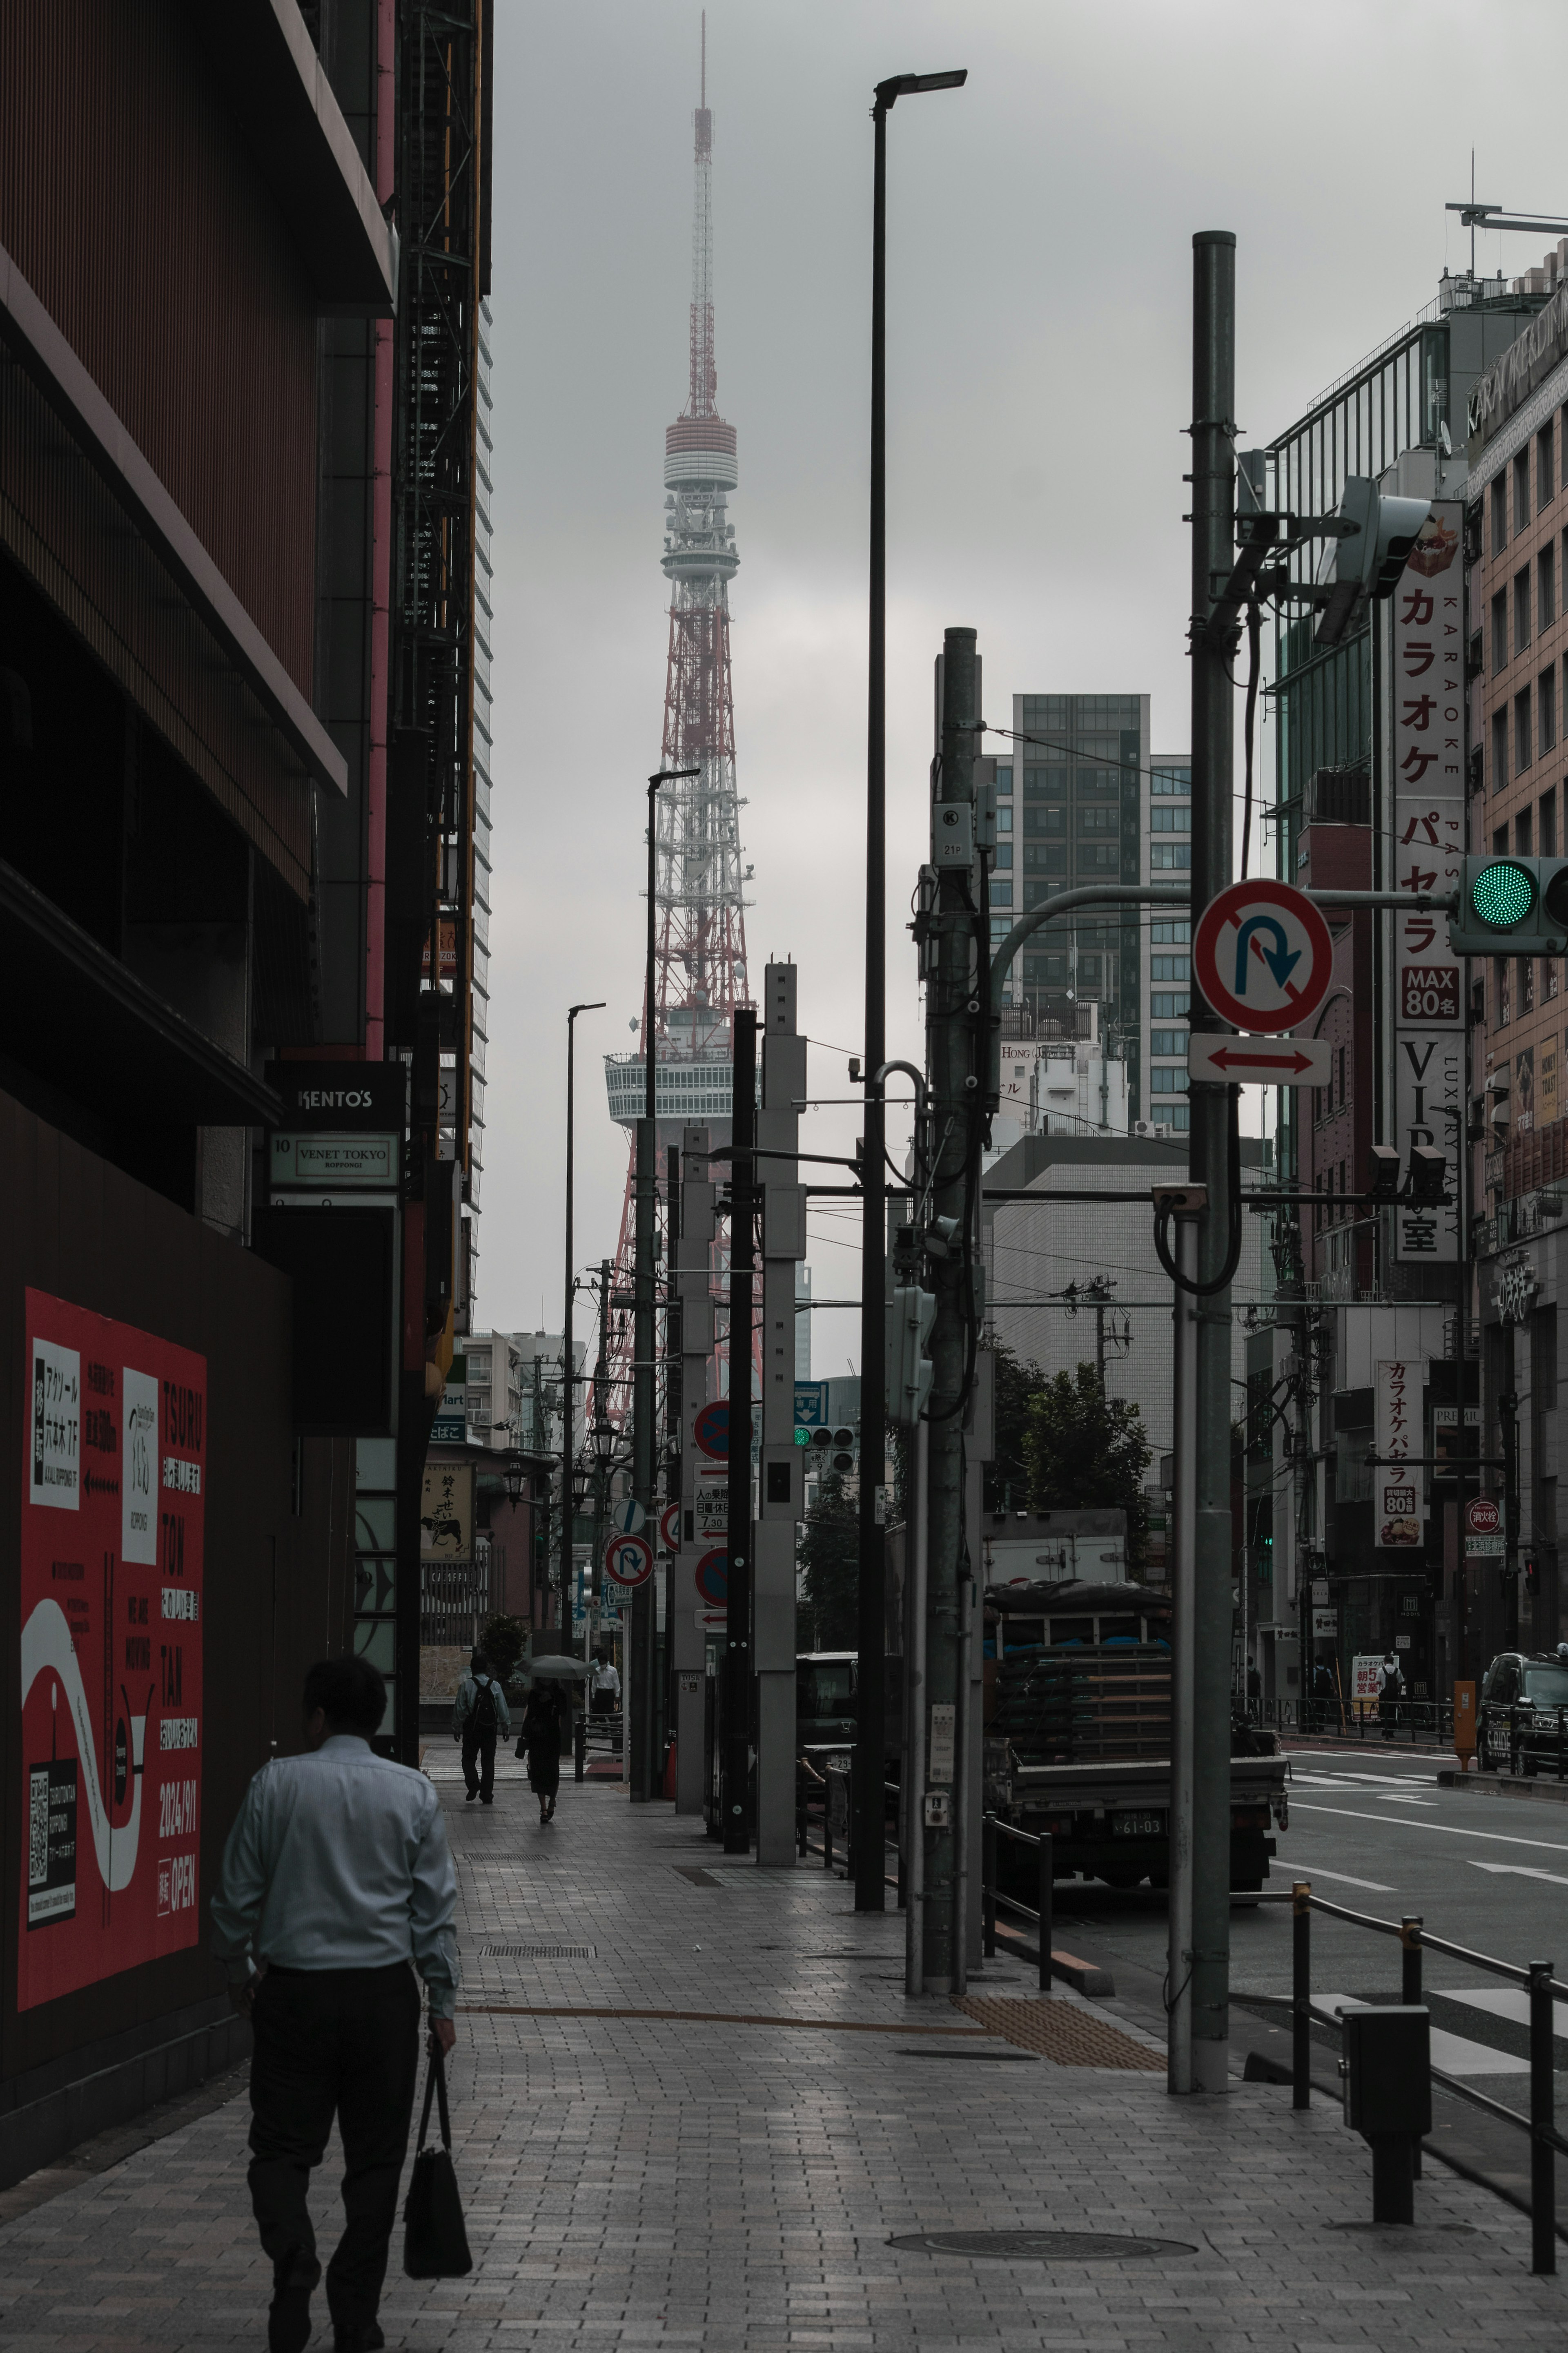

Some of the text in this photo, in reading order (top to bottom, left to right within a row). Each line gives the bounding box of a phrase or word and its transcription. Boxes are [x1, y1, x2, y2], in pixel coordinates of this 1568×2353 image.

[1400, 589, 1439, 783] カラオケ
[1444, 598, 1459, 774] KARAOKE
[944, 845, 961, 855] 21P
[1400, 811, 1440, 954] パセラ
[1407, 970, 1453, 988] MAX
[1406, 990, 1455, 1015] 80名
[1542, 1053, 1556, 1075] HONEY
[298, 1090, 372, 1110] KENTO'S
[1542, 1075, 1556, 1097] TOAST
[1444, 1056, 1458, 1157] LUXURY
[275, 1140, 290, 1153] 10
[301, 1150, 386, 1160] VENET TOKYO
[47, 1367, 78, 1403] アクソール
[164, 1381, 202, 1452] TSURU
[796, 1399, 817, 1408] 専用
[36, 1379, 43, 1463] 移転
[46, 1413, 78, 1456] 六本木 7F
[1388, 1363, 1409, 1484] カラオケパセラ
[701, 1516, 722, 1528] 7.30
[1472, 1511, 1497, 1523] 消火栓
[163, 1513, 184, 1577] TON
[1472, 1541, 1504, 1550] 北浜診療所
[161, 1646, 182, 1707] TAN
[160, 1780, 196, 1838] 2024/9/1
[1123, 1820, 1160, 1833] 61-03
[171, 1854, 195, 1911] OPEN
